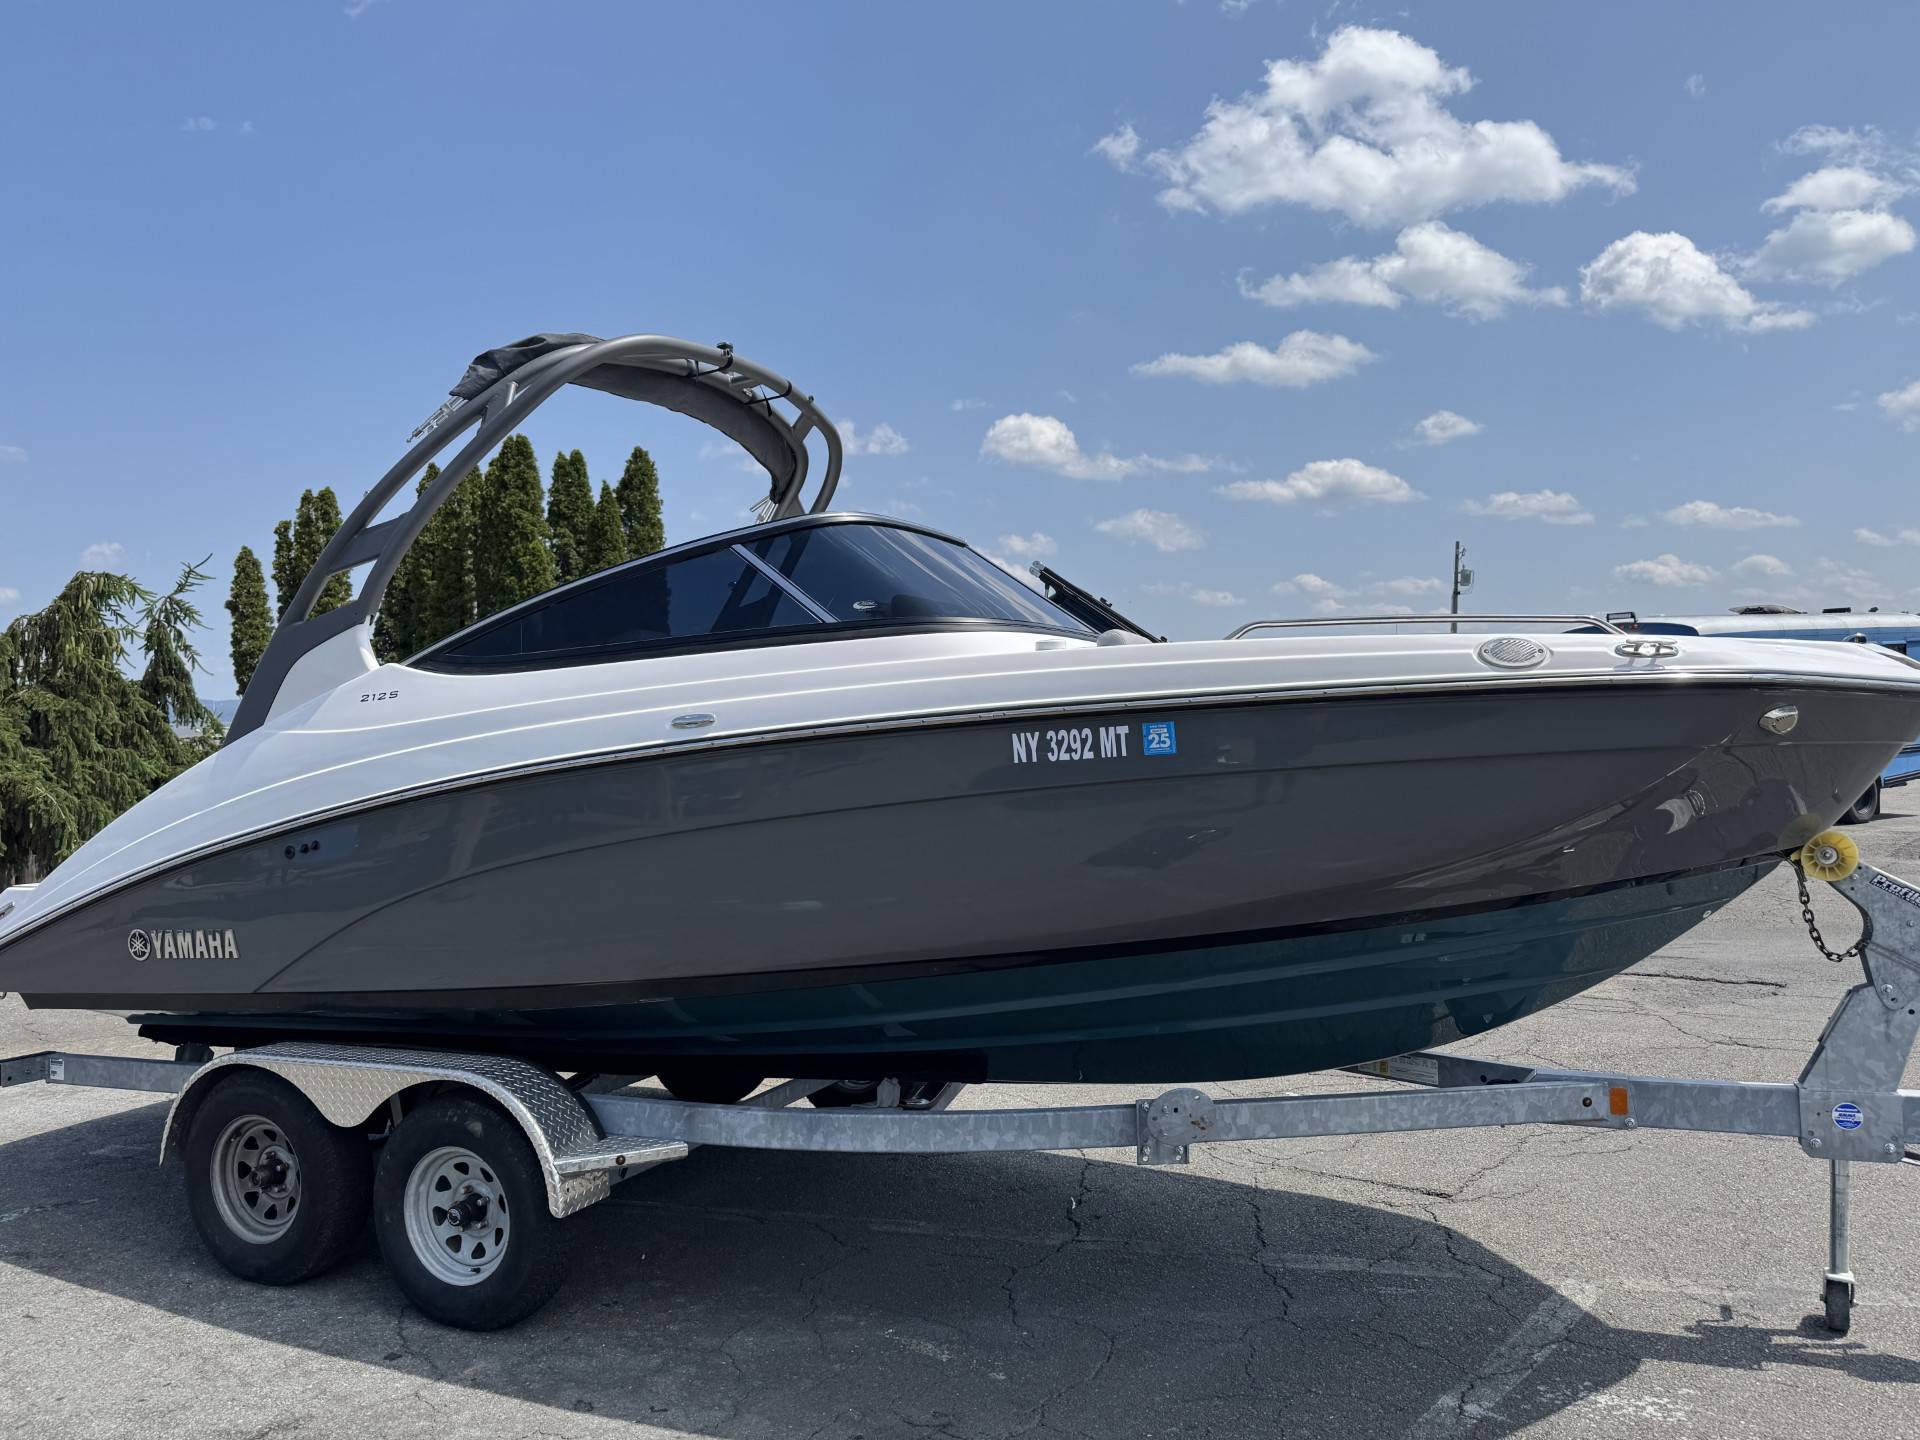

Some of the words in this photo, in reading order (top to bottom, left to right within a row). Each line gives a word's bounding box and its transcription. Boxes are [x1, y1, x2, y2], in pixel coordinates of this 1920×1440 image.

[360, 690, 399, 702] 212S
[1012, 731, 1040, 763] NY
[1046, 728, 1095, 762] 3292
[1100, 725, 1130, 758] MT
[1148, 733, 1171, 749] 25
[151, 928, 239, 959] YAMAHA
